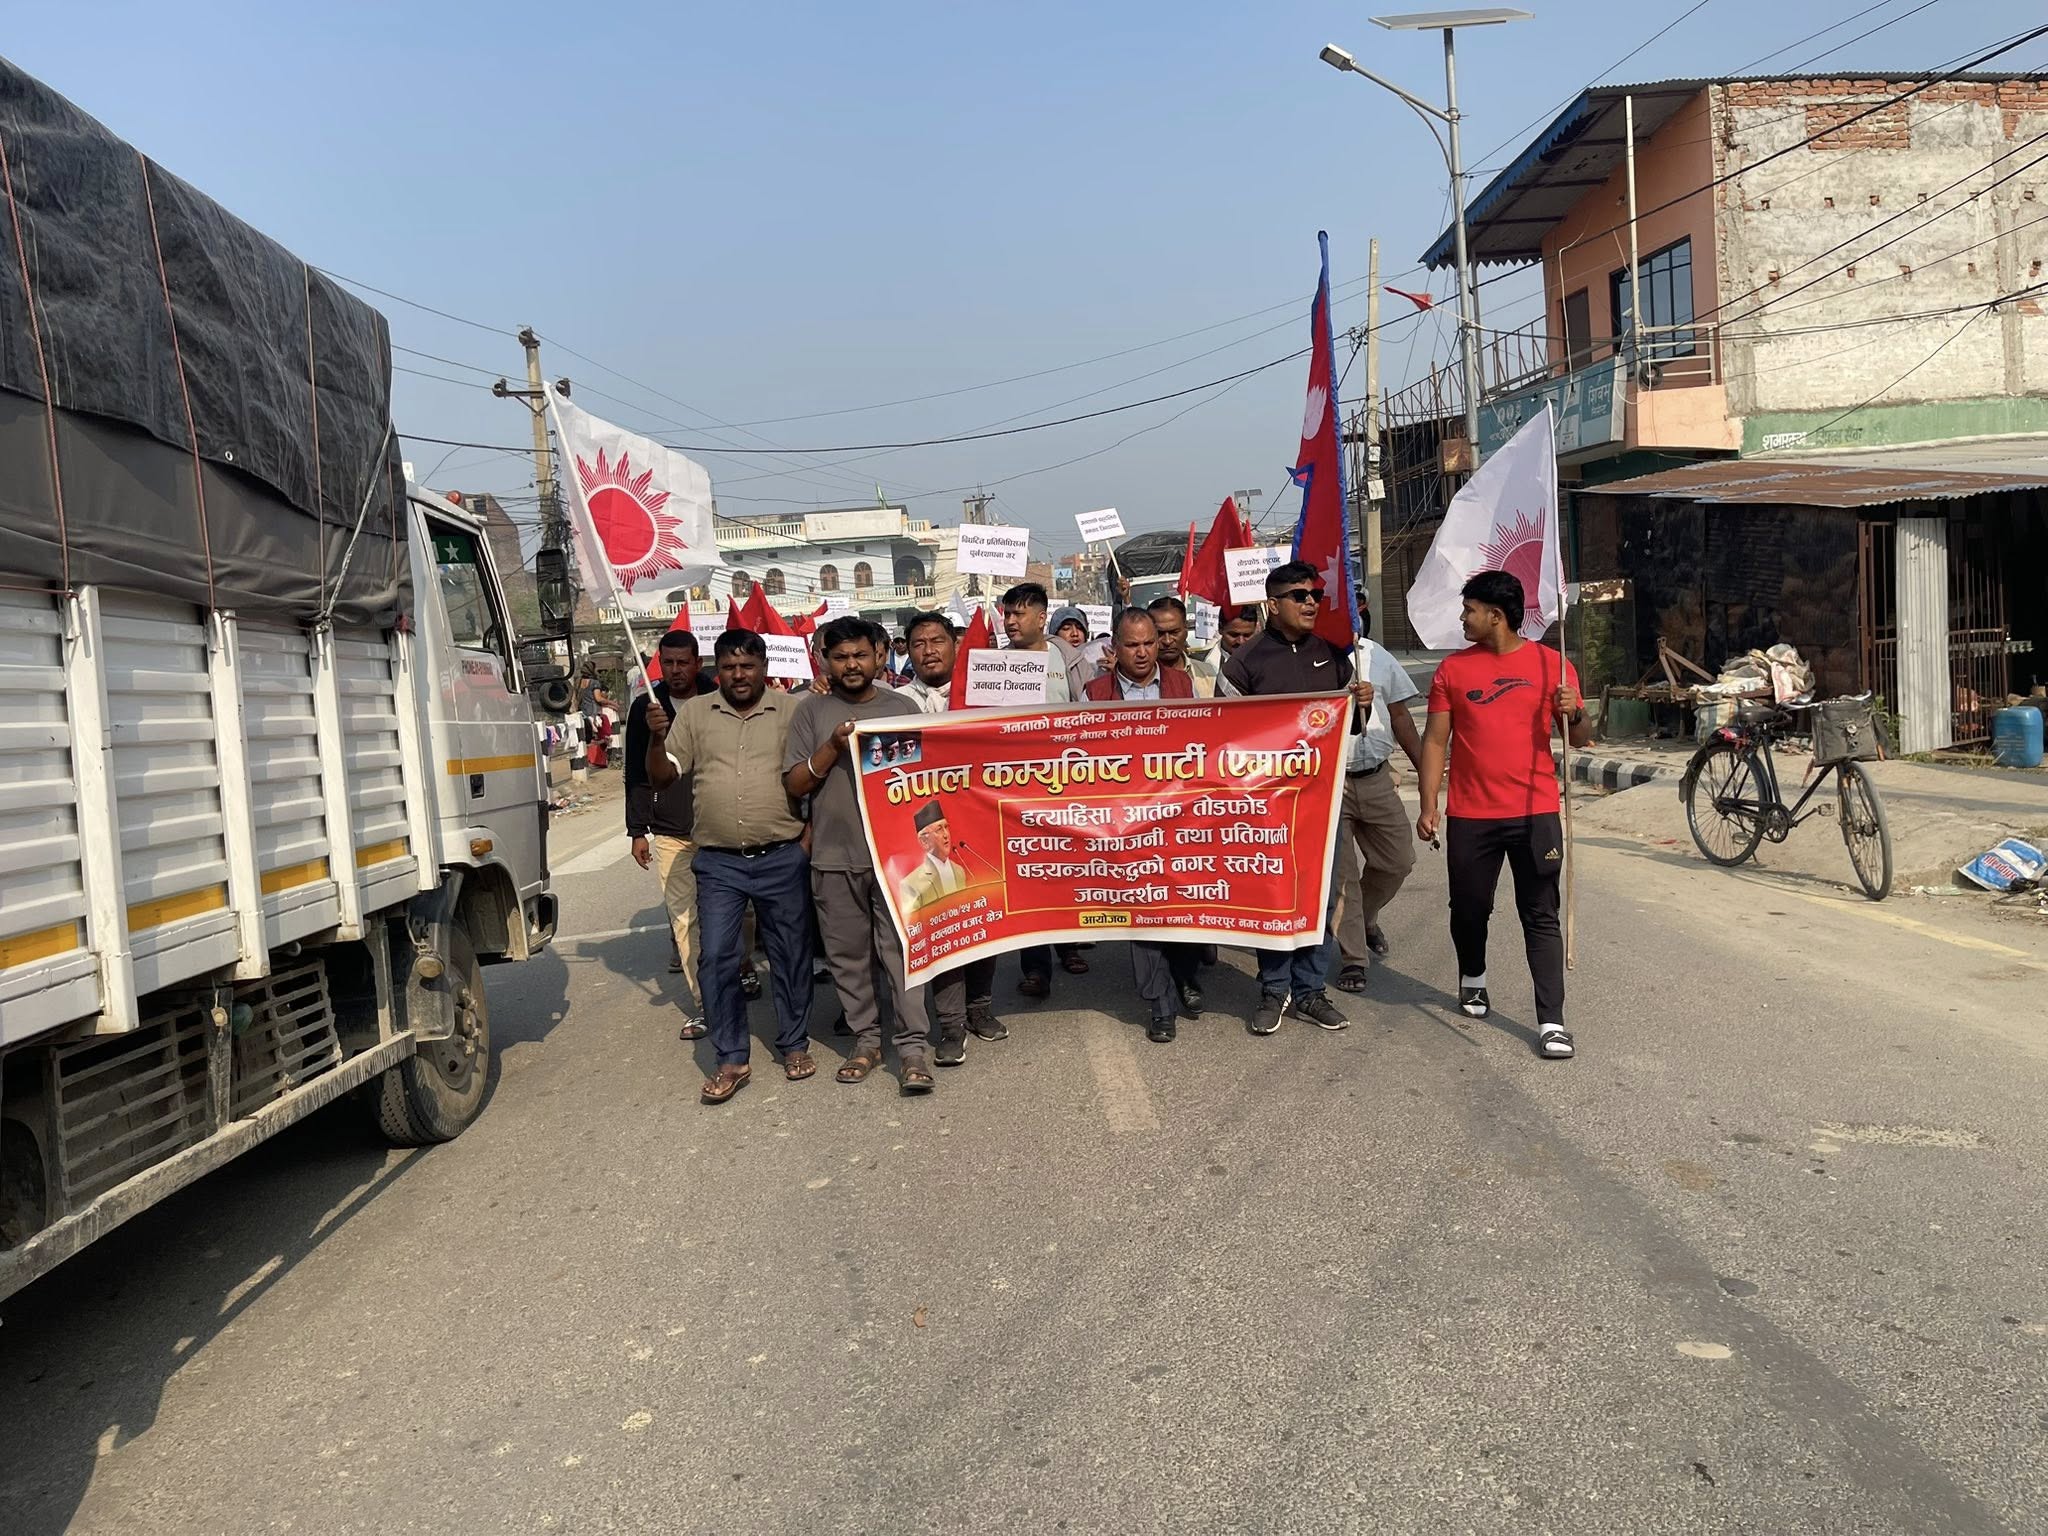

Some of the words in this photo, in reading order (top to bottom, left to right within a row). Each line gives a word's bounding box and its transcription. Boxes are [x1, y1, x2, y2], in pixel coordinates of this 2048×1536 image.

[972, 661, 1007, 673] जनताको
[972, 681, 1001, 691] जनवाद
[1004, 679, 1042, 692] जिन्दावाद
[1000, 716, 1050, 734] जनताको
[1053, 711, 1106, 730] बहुदलिय
[1110, 709, 1152, 722] जनवाद
[1156, 706, 1213, 720] जिन्दावाद
[1080, 728, 1107, 741] नेपाल
[1110, 725, 1132, 739] सुखी
[884, 764, 973, 804] नेपाल
[982, 747, 1133, 794] कम्युनिष्ट
[1142, 742, 1207, 781] पार्टी
[1218, 739, 1322, 780] (एमाले)
[1175, 828, 1214, 844] तथा
[1219, 821, 1289, 845] प्रतिगामी
[1171, 855, 1217, 872] नगर
[1223, 852, 1284, 875] स्तरीय
[1074, 883, 1169, 905] जनप्रदर्शन
[1082, 912, 1128, 925] आयोजक
[1135, 914, 1164, 925] नेकपा
[1238, 917, 1262, 930] नगर
[1262, 918, 1293, 932] कमिटी
